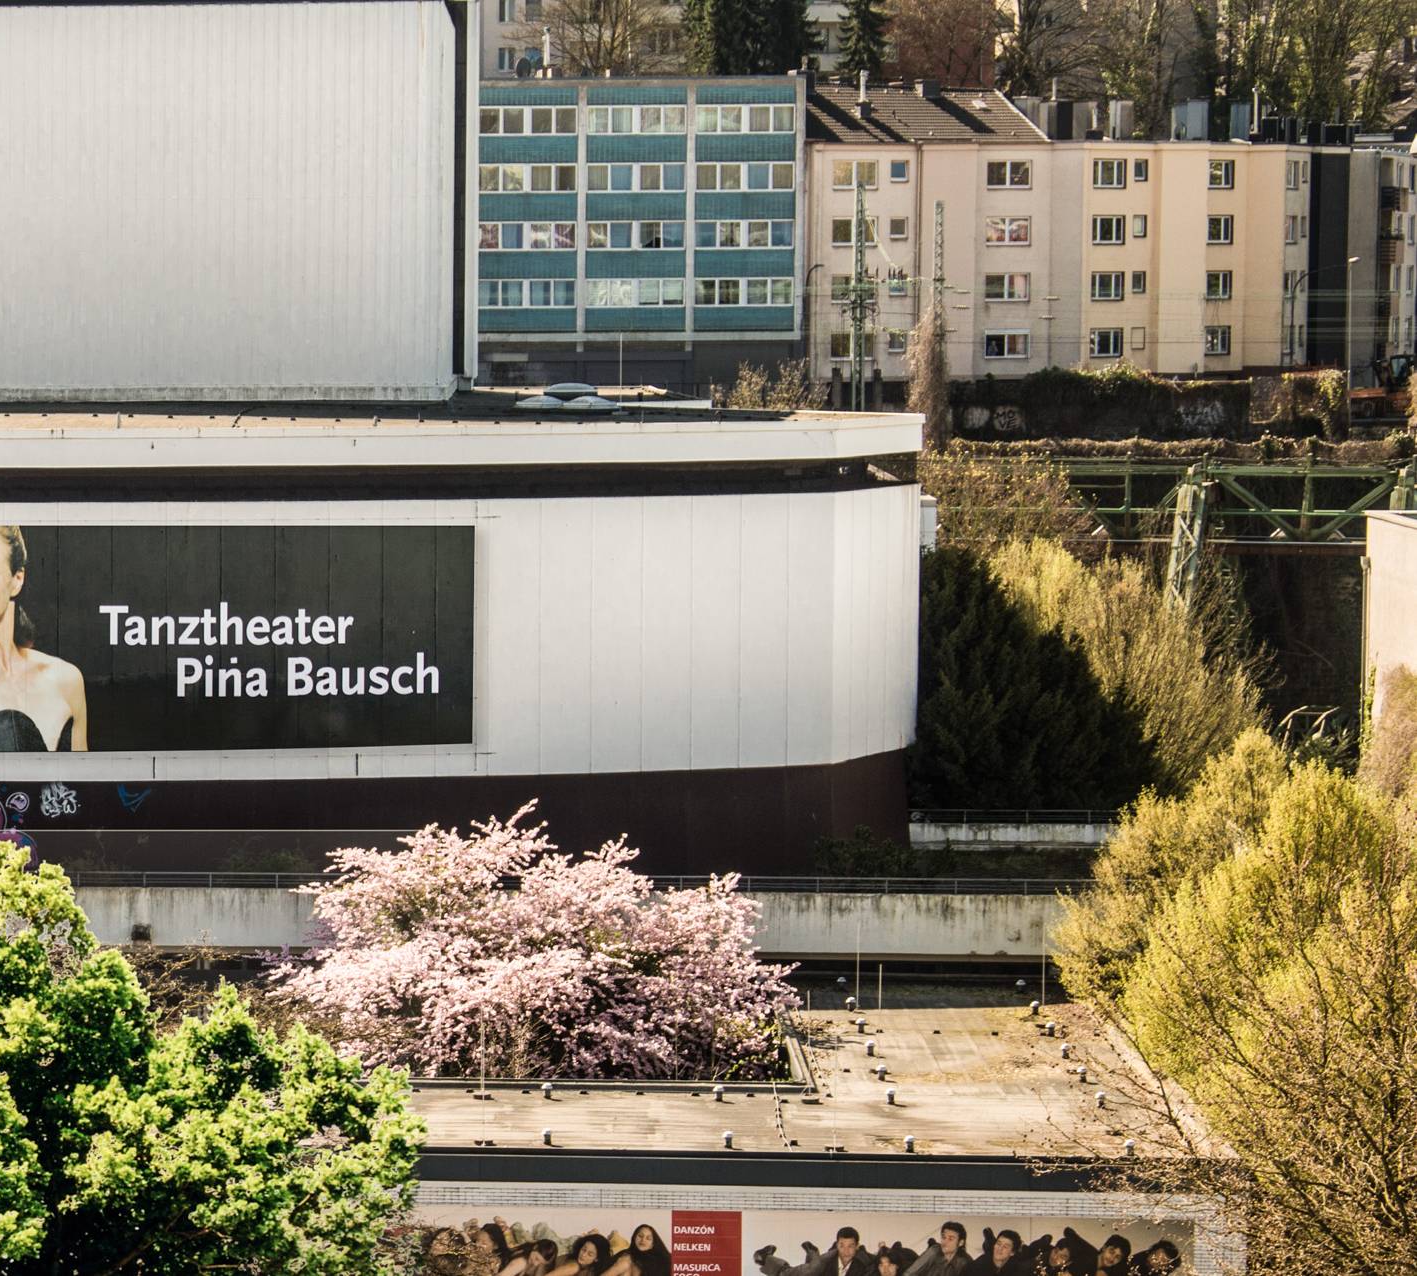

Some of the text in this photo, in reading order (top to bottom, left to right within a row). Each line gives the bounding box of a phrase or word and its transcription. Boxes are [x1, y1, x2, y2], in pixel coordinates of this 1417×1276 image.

[99, 602, 354, 645] Tanztheater
[287, 652, 440, 697] Bausch
[673, 1225, 715, 1235] DANZÓN
[673, 1243, 711, 1252] NELKEN
[673, 1263, 721, 1272] MASURCA
